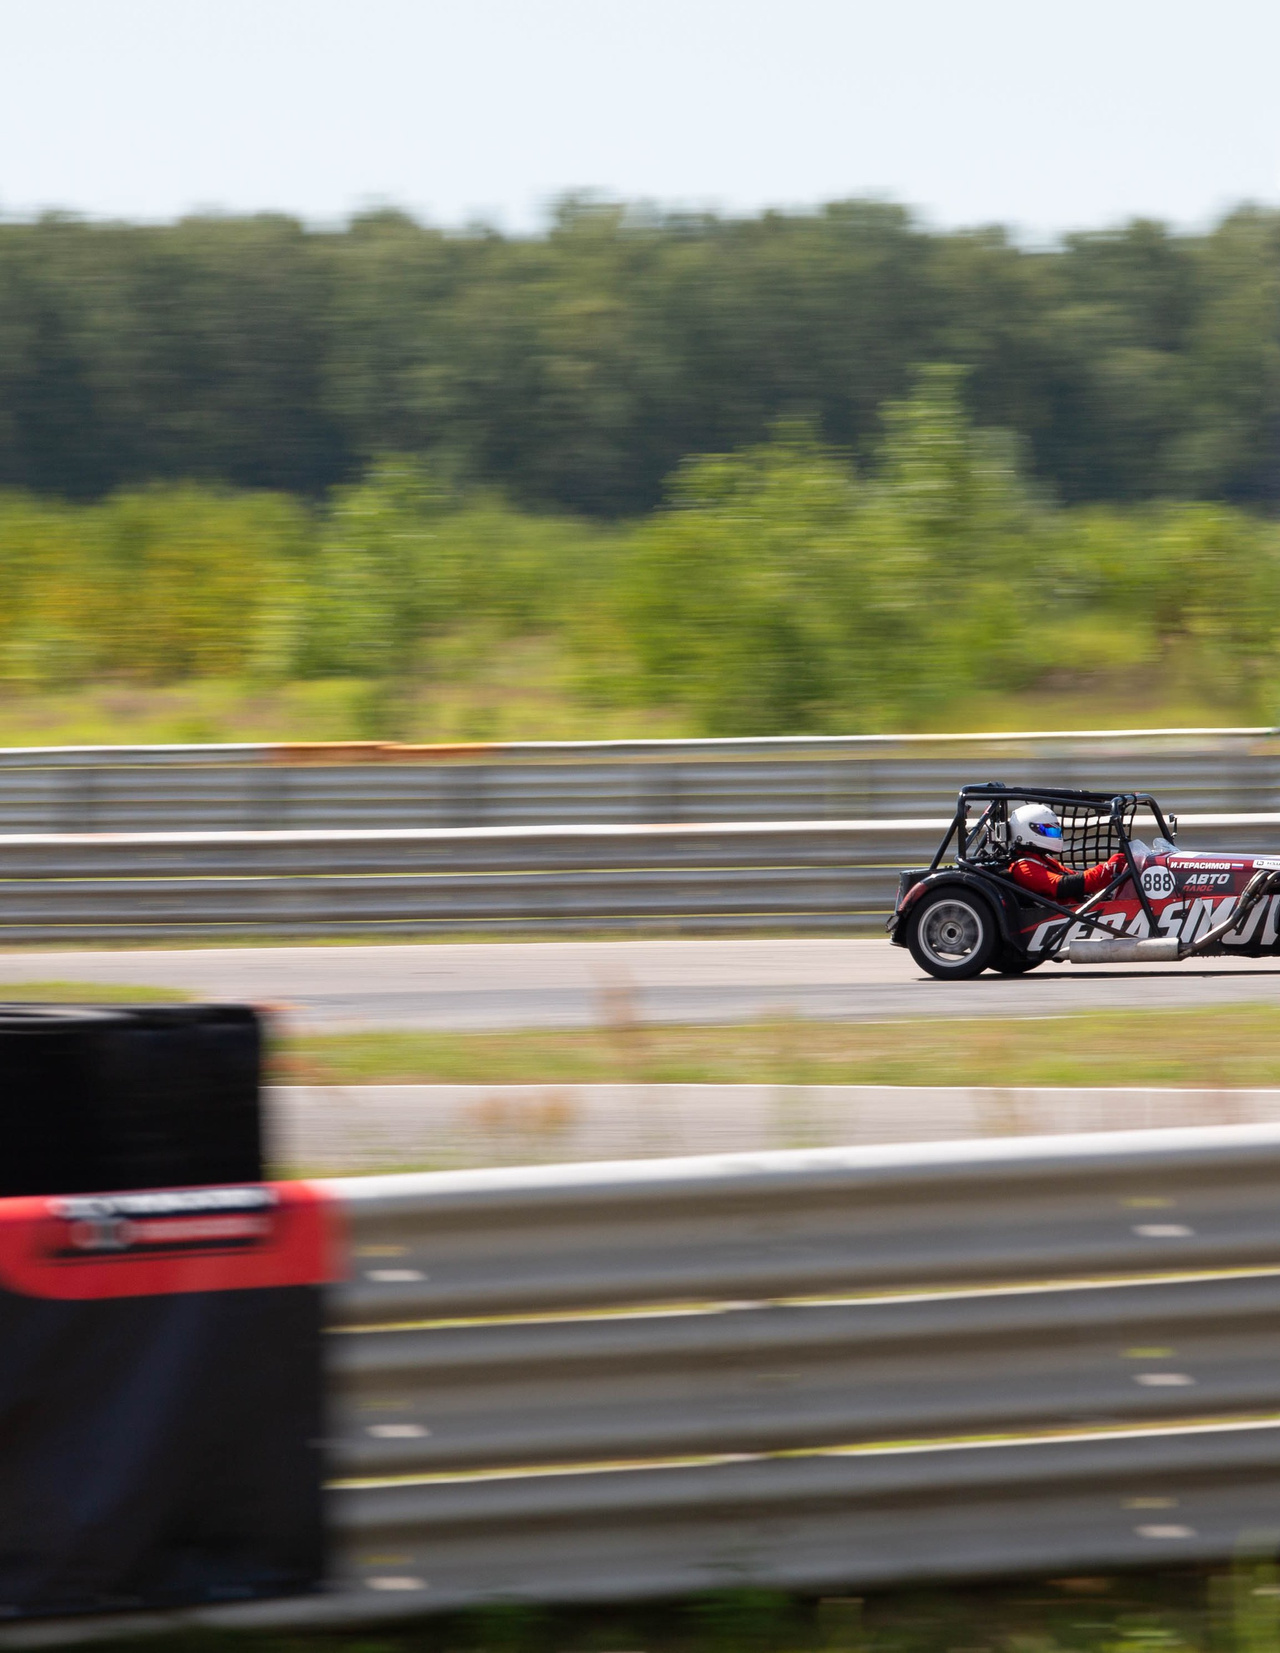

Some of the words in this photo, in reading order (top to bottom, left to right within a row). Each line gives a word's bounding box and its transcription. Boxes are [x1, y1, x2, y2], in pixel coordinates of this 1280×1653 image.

[1170, 861, 1231, 870] И.ГЕРАСИМОВ
[1143, 873, 1171, 892] 888
[1185, 873, 1230, 885] АВТО
